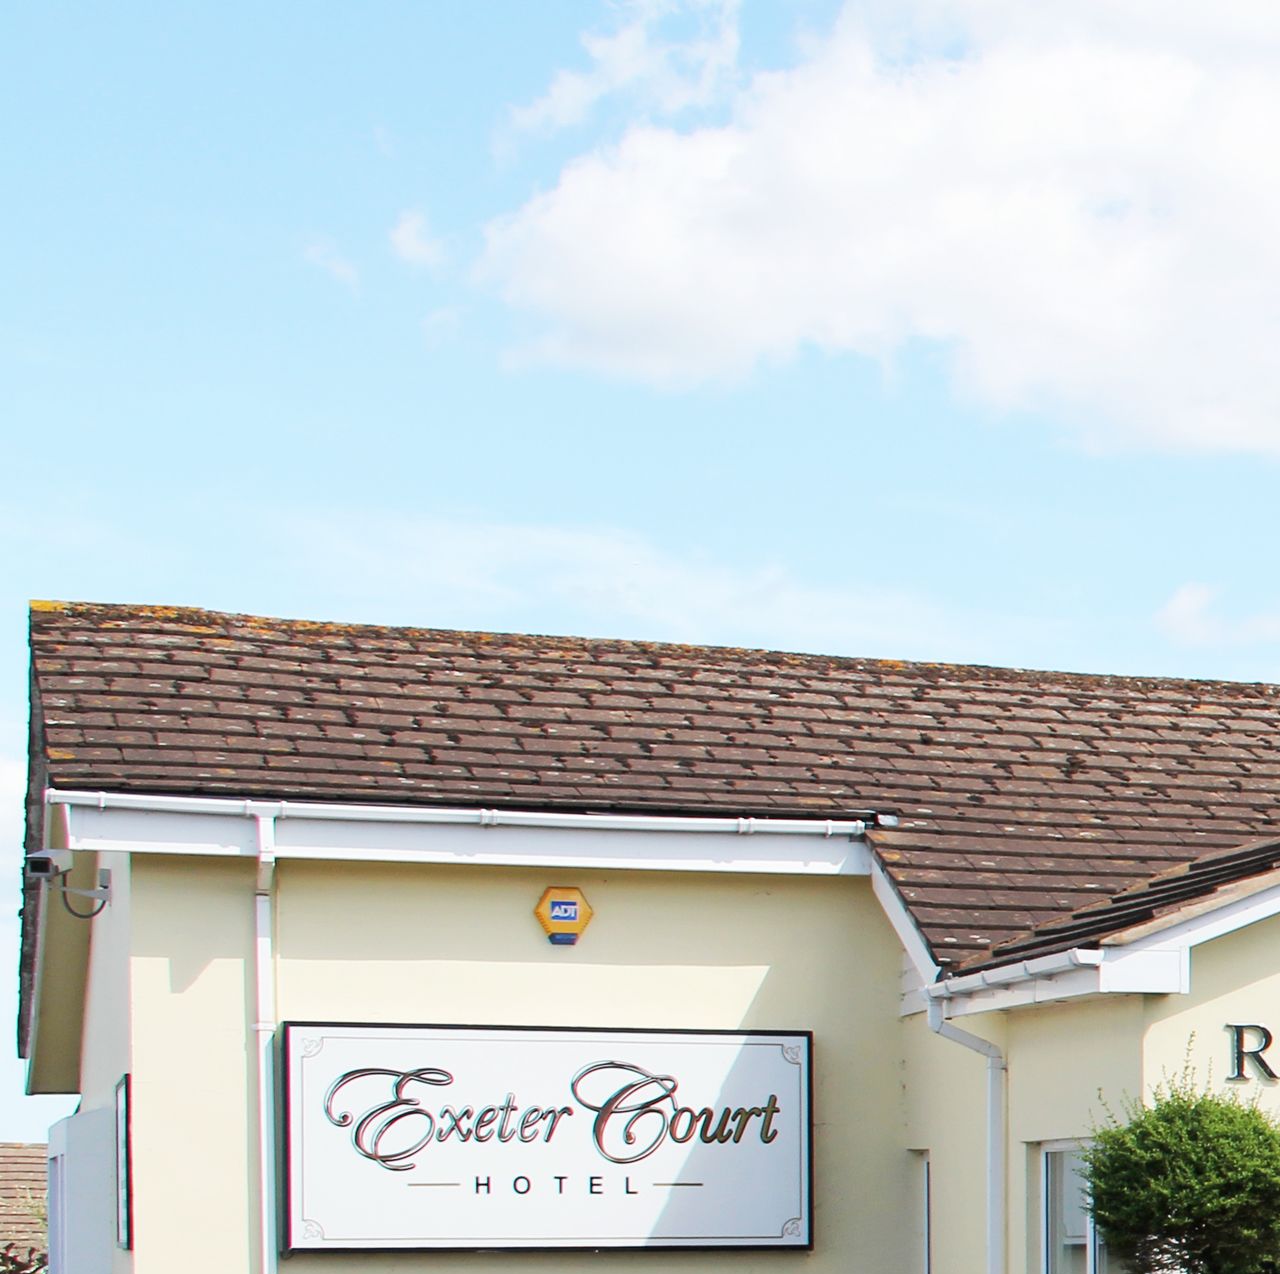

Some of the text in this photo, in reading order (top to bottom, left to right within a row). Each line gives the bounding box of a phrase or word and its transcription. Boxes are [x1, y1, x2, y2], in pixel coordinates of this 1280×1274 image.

[551, 904, 579, 918] ADT
[322, 1059, 781, 1172] Exeter Court
[474, 1175, 639, 1195] HOTEL
